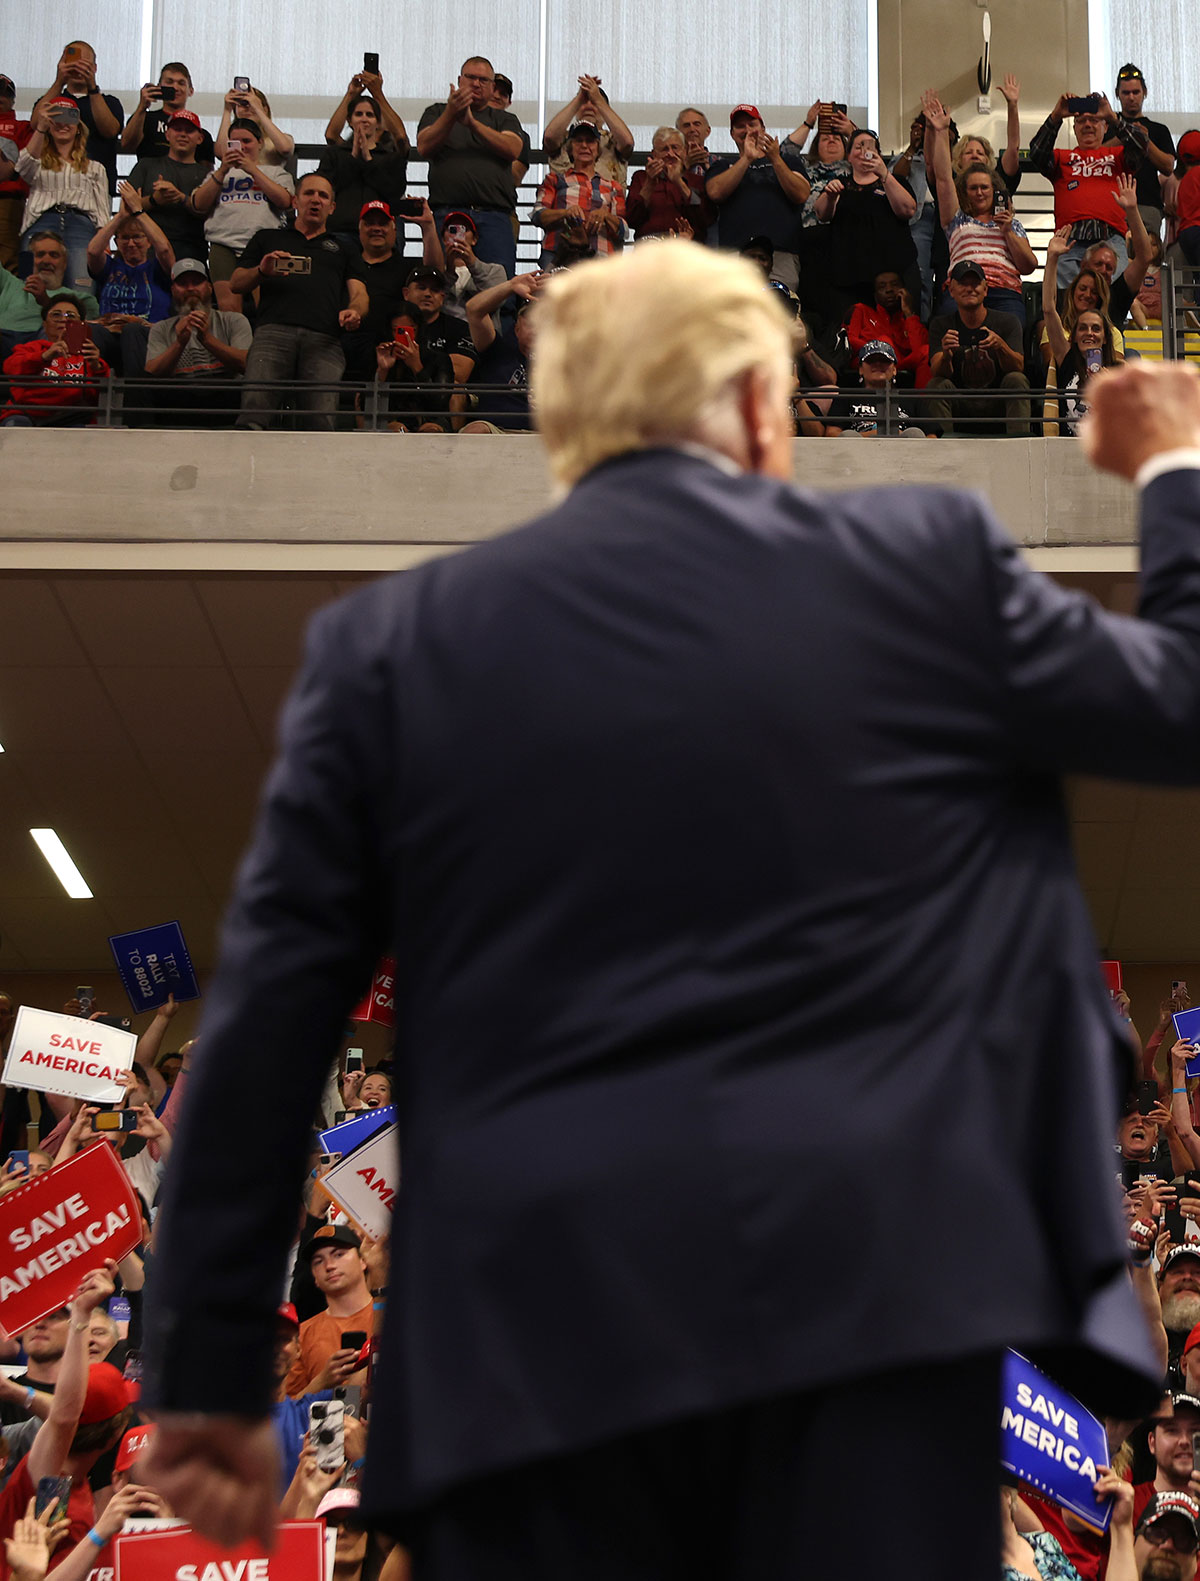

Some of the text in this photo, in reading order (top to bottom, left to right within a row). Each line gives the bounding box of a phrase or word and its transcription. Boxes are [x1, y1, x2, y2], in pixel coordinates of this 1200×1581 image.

[1071, 166, 1112, 177] 2024
[219, 193, 253, 203] OTTA
[128, 948, 154, 998] TO 88022
[146, 954, 167, 984] RALLY
[163, 952, 181, 979] TEXT
[49, 1034, 103, 1056] SAVE
[19, 1049, 122, 1081] AMERICA!
[8, 1192, 90, 1253] SAVE
[0, 1203, 131, 1303] AMERICA!
[1016, 1382, 1080, 1441] SAVE
[1000, 1405, 1098, 1484] MERICA
[175, 1557, 270, 1581] SAVE
